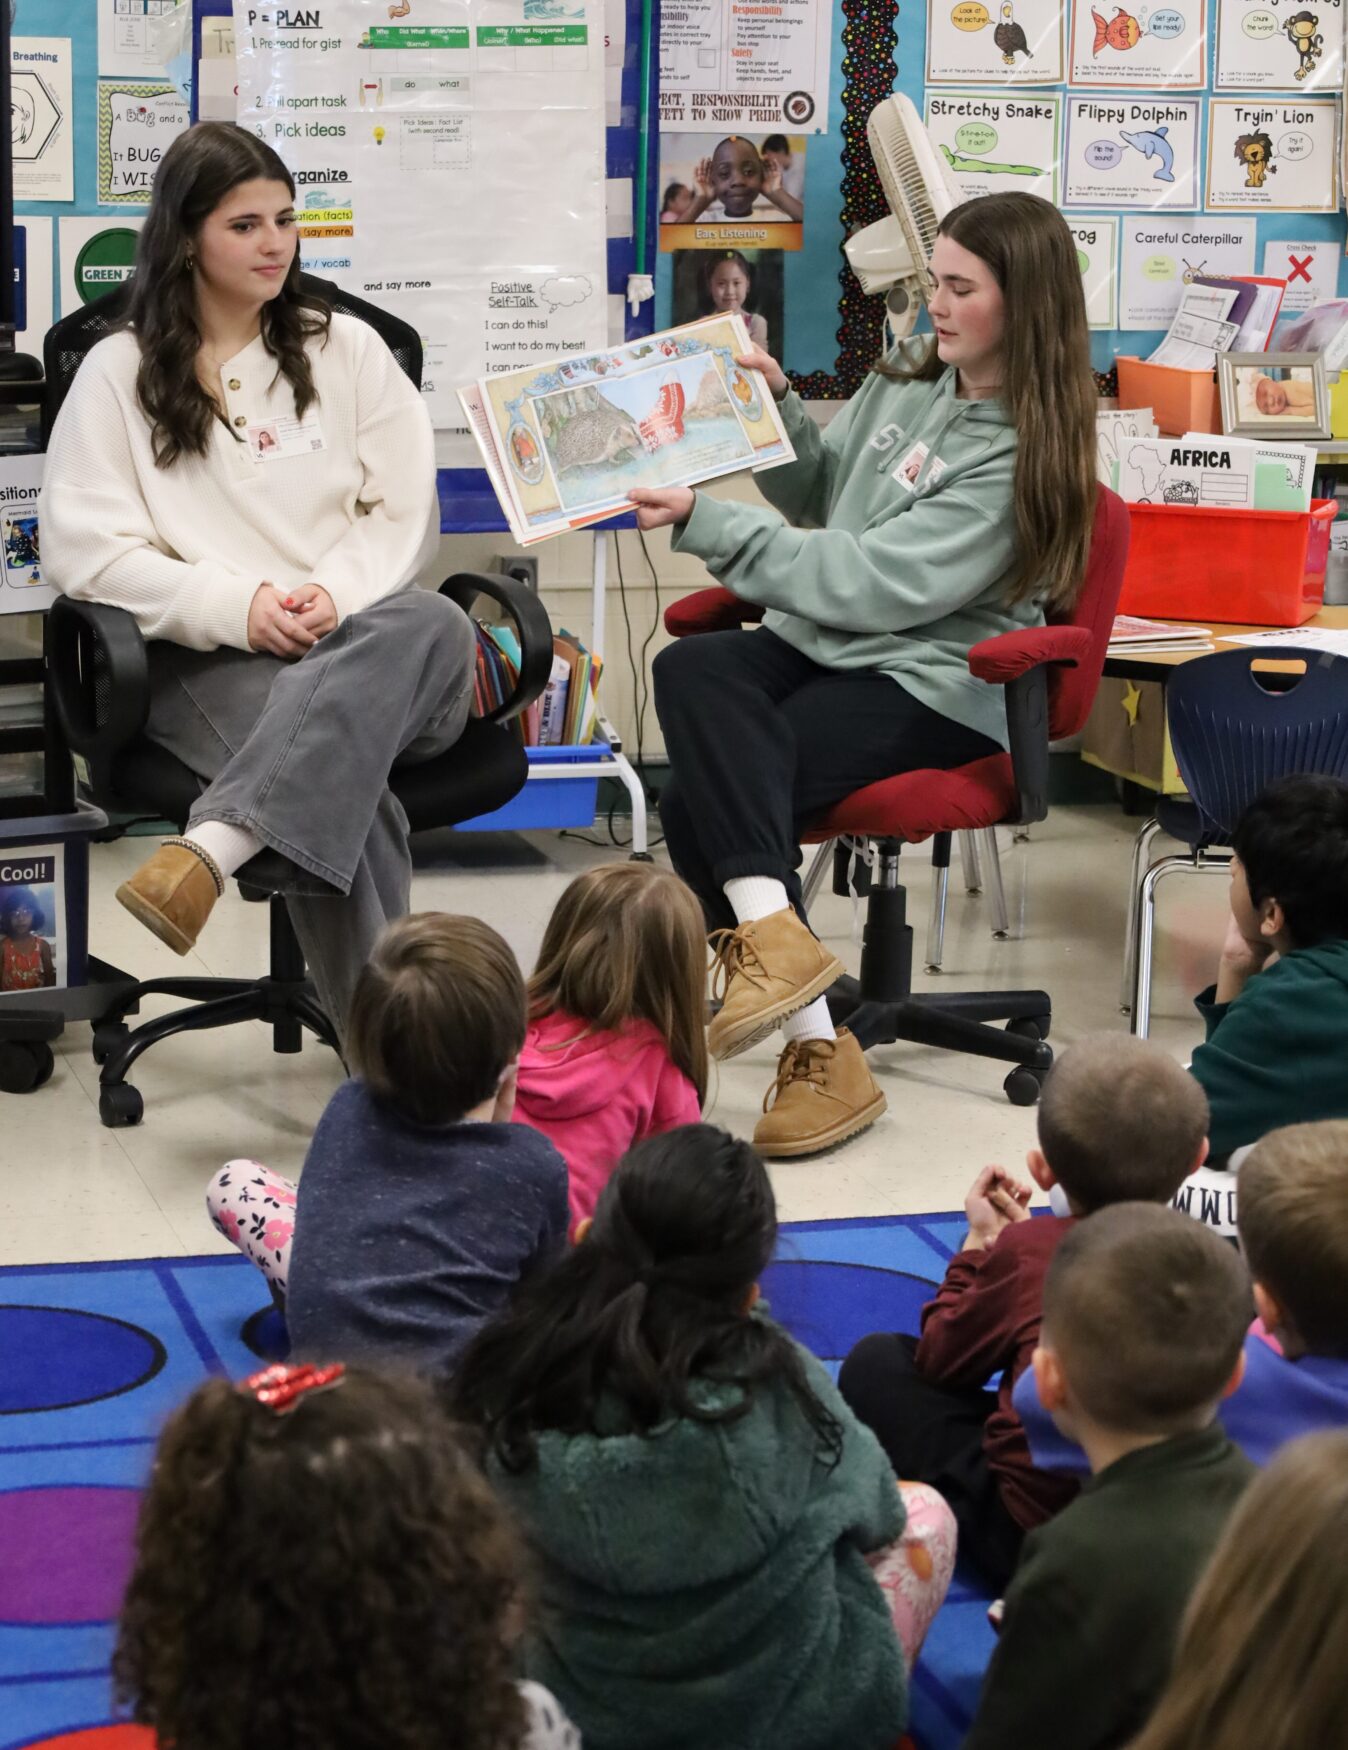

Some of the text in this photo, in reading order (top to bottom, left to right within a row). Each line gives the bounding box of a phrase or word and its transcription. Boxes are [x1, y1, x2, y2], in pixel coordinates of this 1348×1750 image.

[660, 12, 688, 22] nsibility
[732, 5, 782, 15] Responsibility
[248, 11, 257, 26] P
[276, 11, 320, 27] PLAN
[302, 37, 318, 49] for
[320, 37, 342, 52] gist
[13, 52, 58, 63] Breathing
[405, 80, 460, 88] do what
[287, 98, 319, 113] apart
[321, 96, 347, 107] task
[660, 93, 781, 107] ECT, RESPONSIBILITY
[115, 113, 122, 121] A
[126, 108, 155, 127] Bug
[159, 114, 176, 123] and
[660, 108, 782, 122] FETY TO SHOW PRIDE
[931, 100, 1053, 121] Stretchy Snake
[1078, 104, 1188, 124] Flippy Dolphin
[1235, 108, 1314, 126] Tryin' Lion
[256, 123, 346, 138] 3. Pick ideas
[113, 147, 162, 162] It BUG
[113, 176, 118, 186] I
[294, 168, 349, 184] rganize
[294, 211, 353, 223] ation (facts)
[303, 226, 354, 238] (say more)
[696, 228, 768, 241] Ears Listening
[1072, 229, 1097, 244] rog
[1135, 232, 1243, 247] Careful Caterpillar
[321, 258, 351, 268] vocab
[84, 268, 123, 281] GREEN
[364, 281, 431, 292] and say more
[491, 281, 533, 293] Positive
[489, 296, 537, 308] Self-Talk
[485, 321, 489, 330] I
[512, 320, 526, 330] do
[527, 320, 548, 330] this!
[485, 340, 585, 352] I want to do my best!
[486, 363, 490, 372] I
[492, 364, 511, 372] can
[1170, 448, 1231, 469] AFRICA
[0, 486, 42, 500] sition
[1, 863, 46, 882] Cool!
